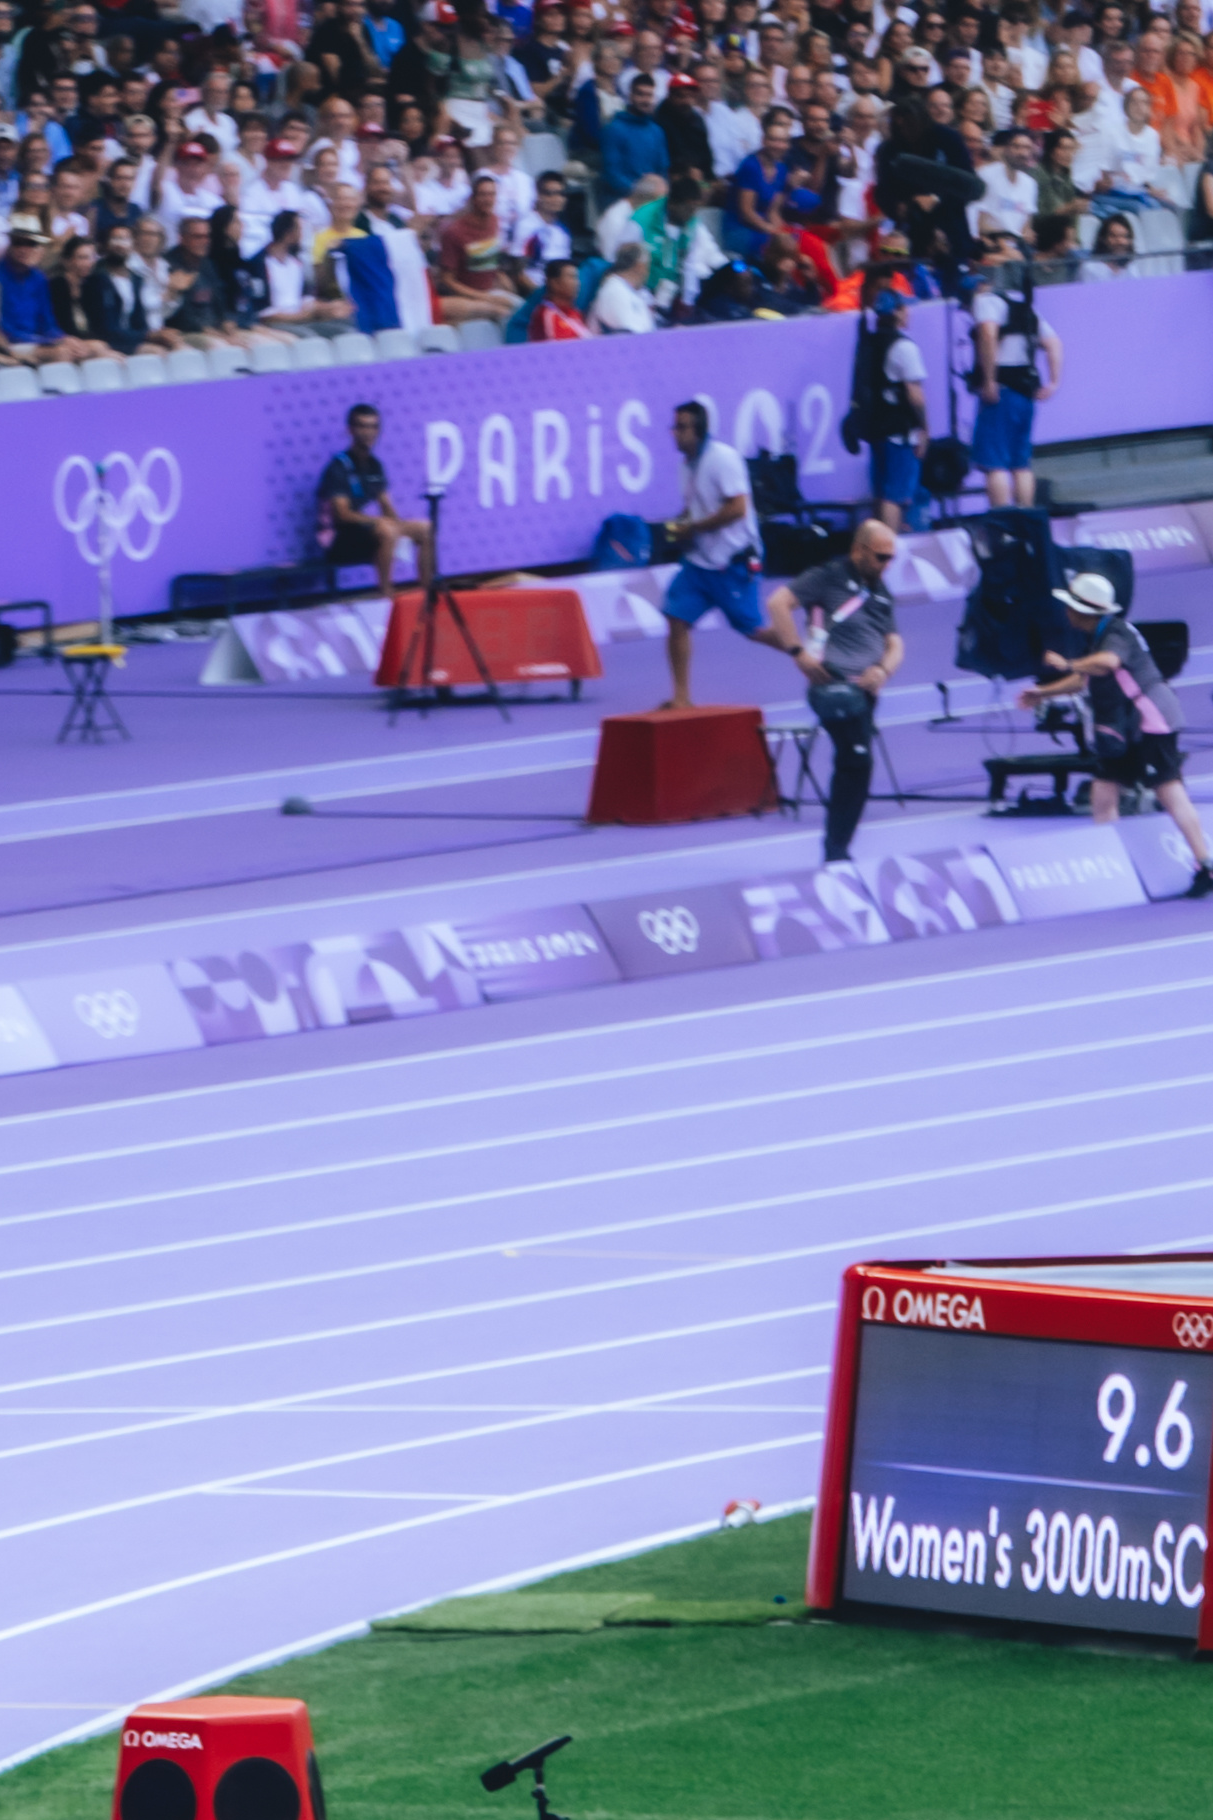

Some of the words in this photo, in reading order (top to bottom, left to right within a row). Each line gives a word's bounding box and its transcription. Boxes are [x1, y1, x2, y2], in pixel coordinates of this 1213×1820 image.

[893, 1289, 986, 1330] OMEGA
[1096, 1373, 1194, 1471] 9.6
[851, 1492, 1014, 1589] Women's
[1021, 1508, 1208, 1608] 3000mSC
[141, 1732, 204, 1750] OMEGA
